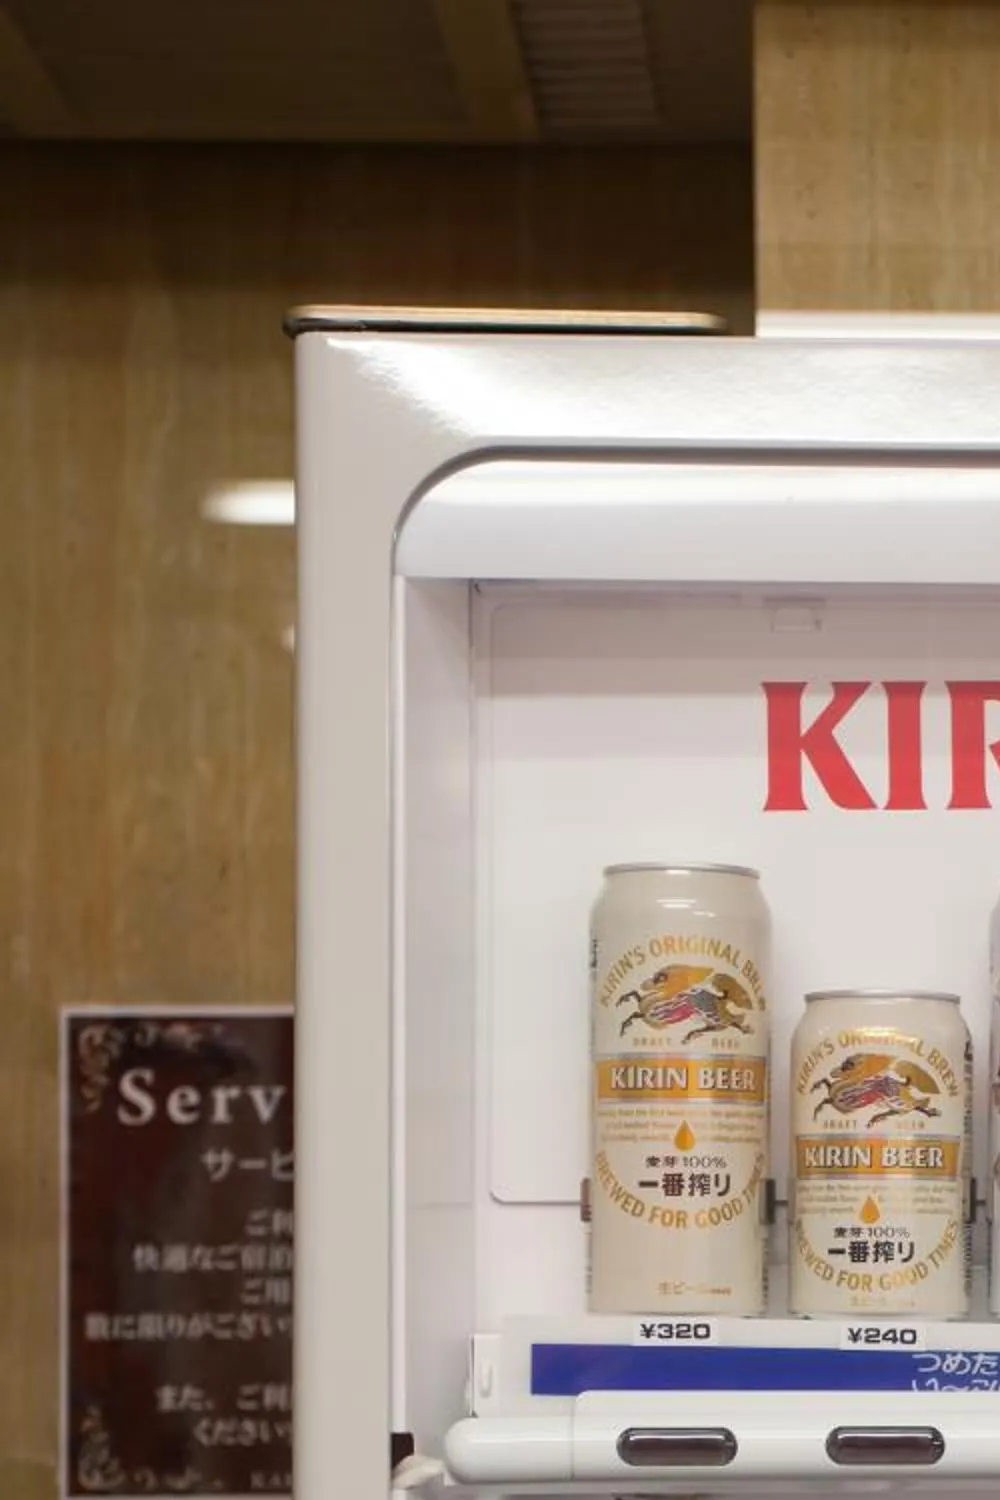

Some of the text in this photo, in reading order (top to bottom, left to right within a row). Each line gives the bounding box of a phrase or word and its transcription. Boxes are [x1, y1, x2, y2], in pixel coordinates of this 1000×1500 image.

[651, 934, 741, 968] ORIGINAL
[838, 1027, 925, 1057] ORAL
[611, 1066, 756, 1091] KIRIN BEER
[805, 1146, 945, 1169] KIRIN BEER
[638, 1172, 732, 1197] 一番搾り
[648, 1206, 689, 1228] FOR
[694, 1198, 745, 1229] GOOD
[828, 1241, 915, 1264] 一番搾り
[836, 1270, 873, 1293] FOR
[640, 1323, 711, 1340] ¥320
[848, 1327, 917, 1345] ¥240
